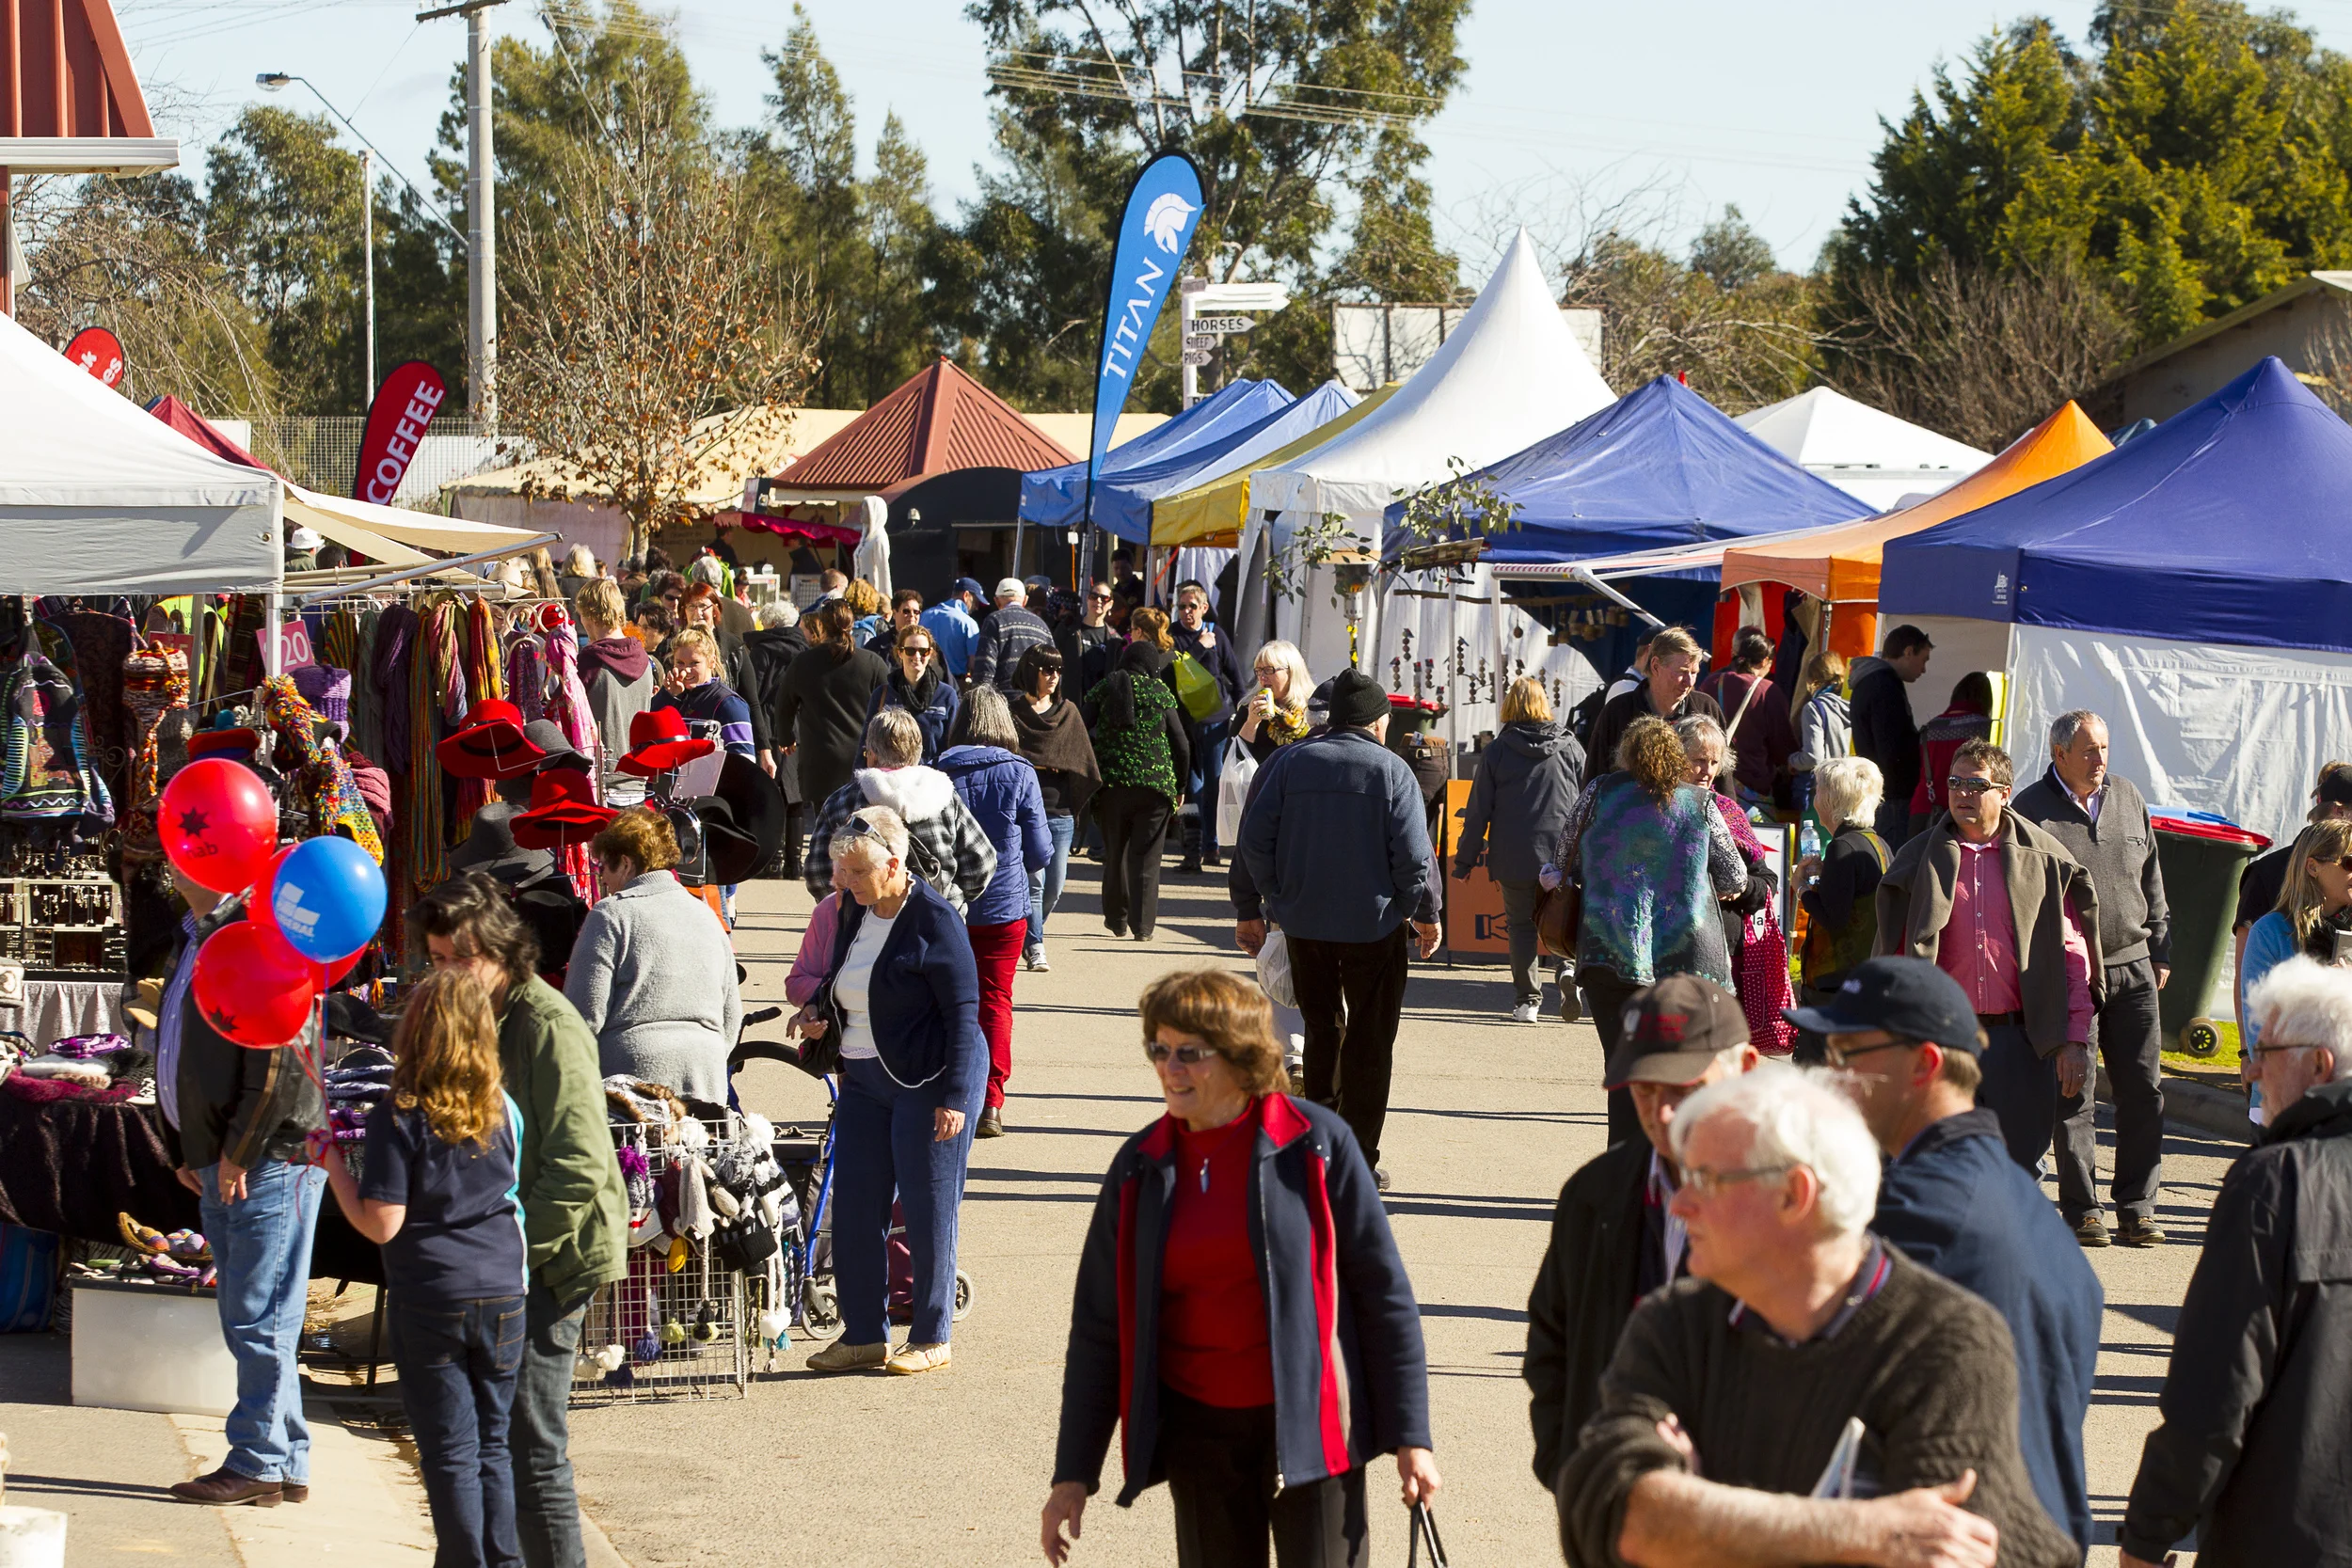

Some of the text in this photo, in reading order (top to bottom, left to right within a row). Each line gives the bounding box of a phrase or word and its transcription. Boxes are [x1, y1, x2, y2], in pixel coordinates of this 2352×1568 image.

[1103, 257, 1164, 379] TITAN
[1191, 318, 1244, 332] HORSES
[1184, 352, 1204, 364] PIGS
[367, 380, 444, 505] COFFEE
[264, 630, 309, 668] 20
[186, 842, 219, 859] nab
